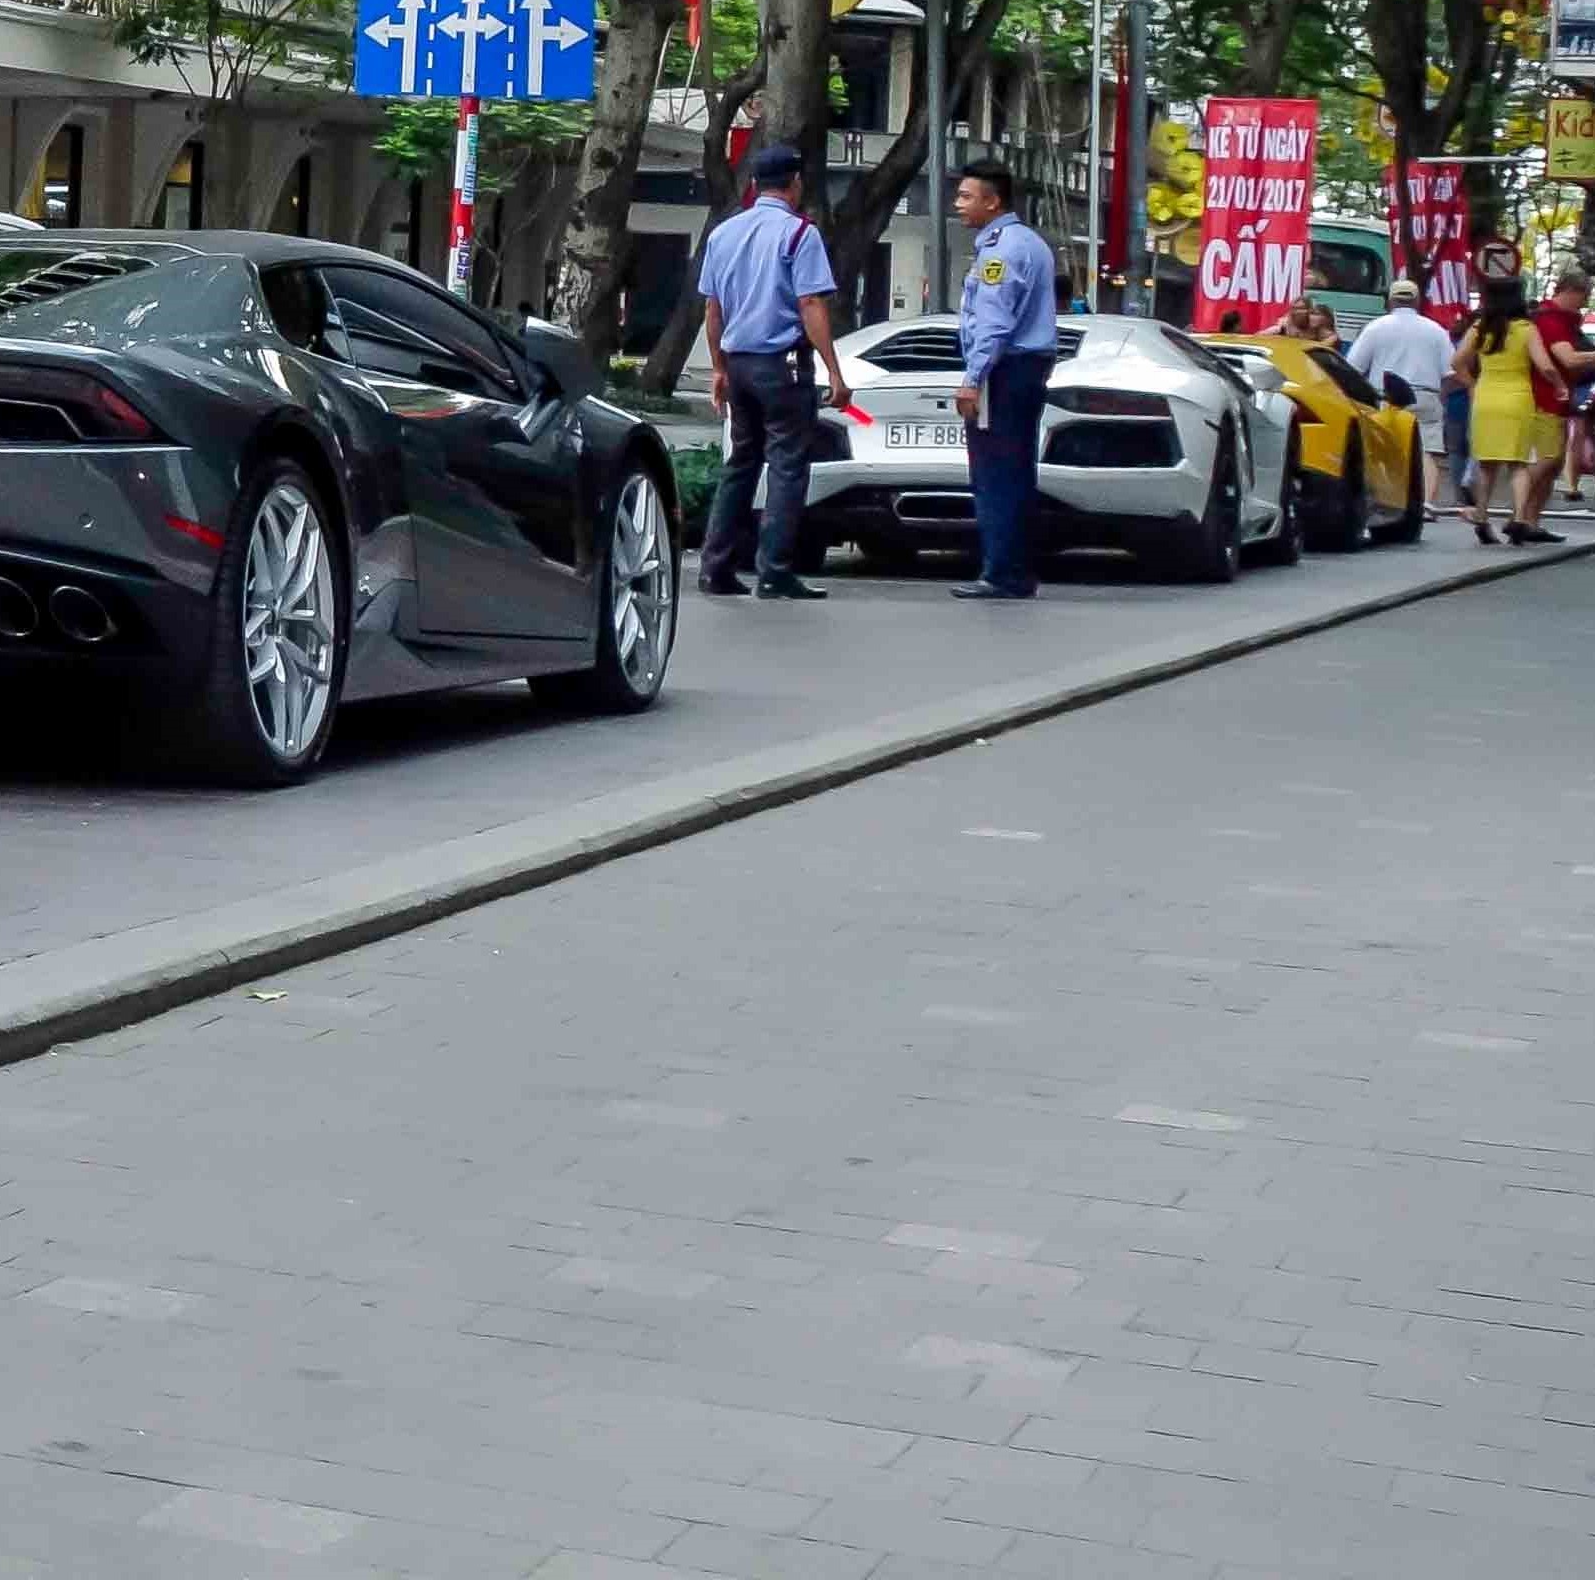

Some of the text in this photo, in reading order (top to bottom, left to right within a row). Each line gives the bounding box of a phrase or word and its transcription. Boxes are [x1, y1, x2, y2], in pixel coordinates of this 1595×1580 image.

[1262, 119, 1310, 162] NGÀY
[1207, 174, 1306, 213] 21/01/2017
[1201, 219, 1304, 304] CẤM
